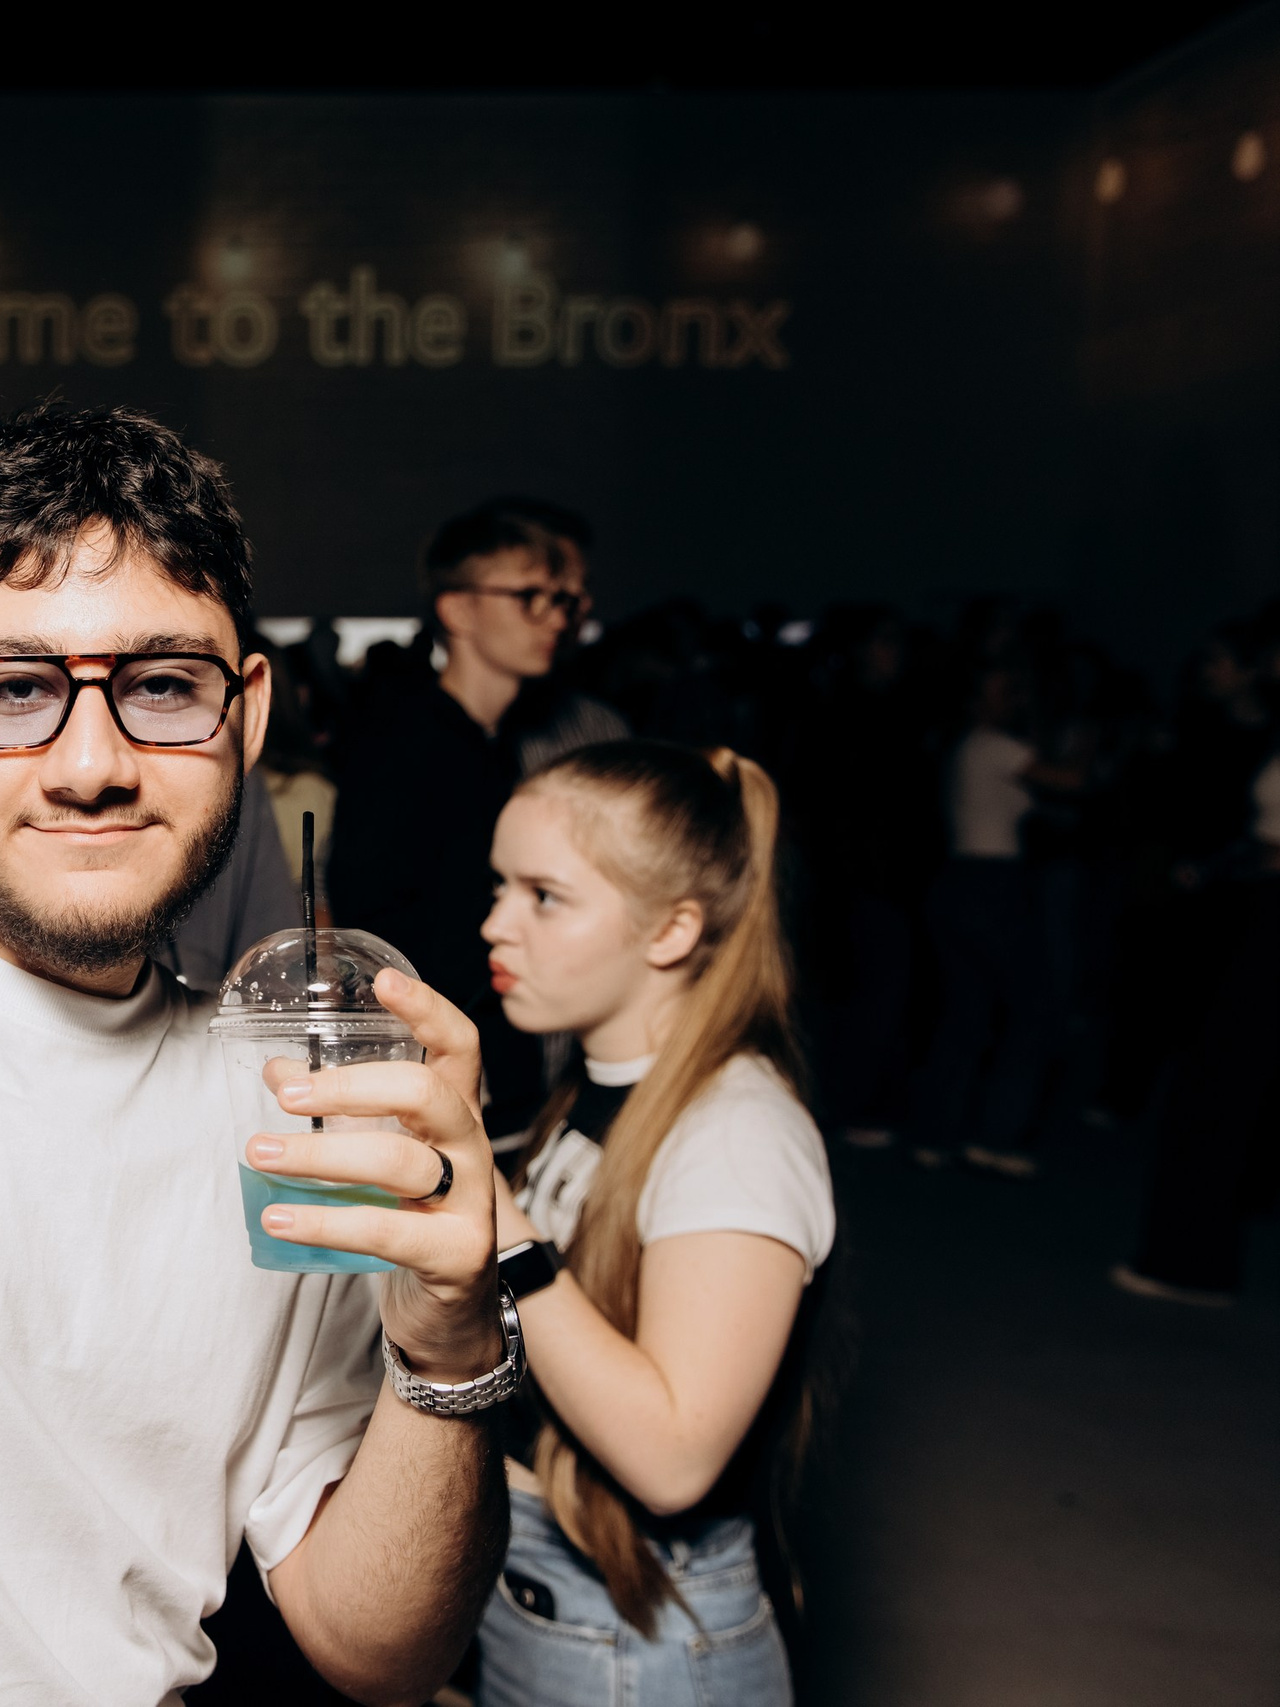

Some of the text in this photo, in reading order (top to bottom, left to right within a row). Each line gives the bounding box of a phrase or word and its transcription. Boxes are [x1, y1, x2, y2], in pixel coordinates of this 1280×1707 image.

[165, 282, 279, 367] to
[300, 266, 465, 367] the
[491, 273, 792, 368] Bronx
